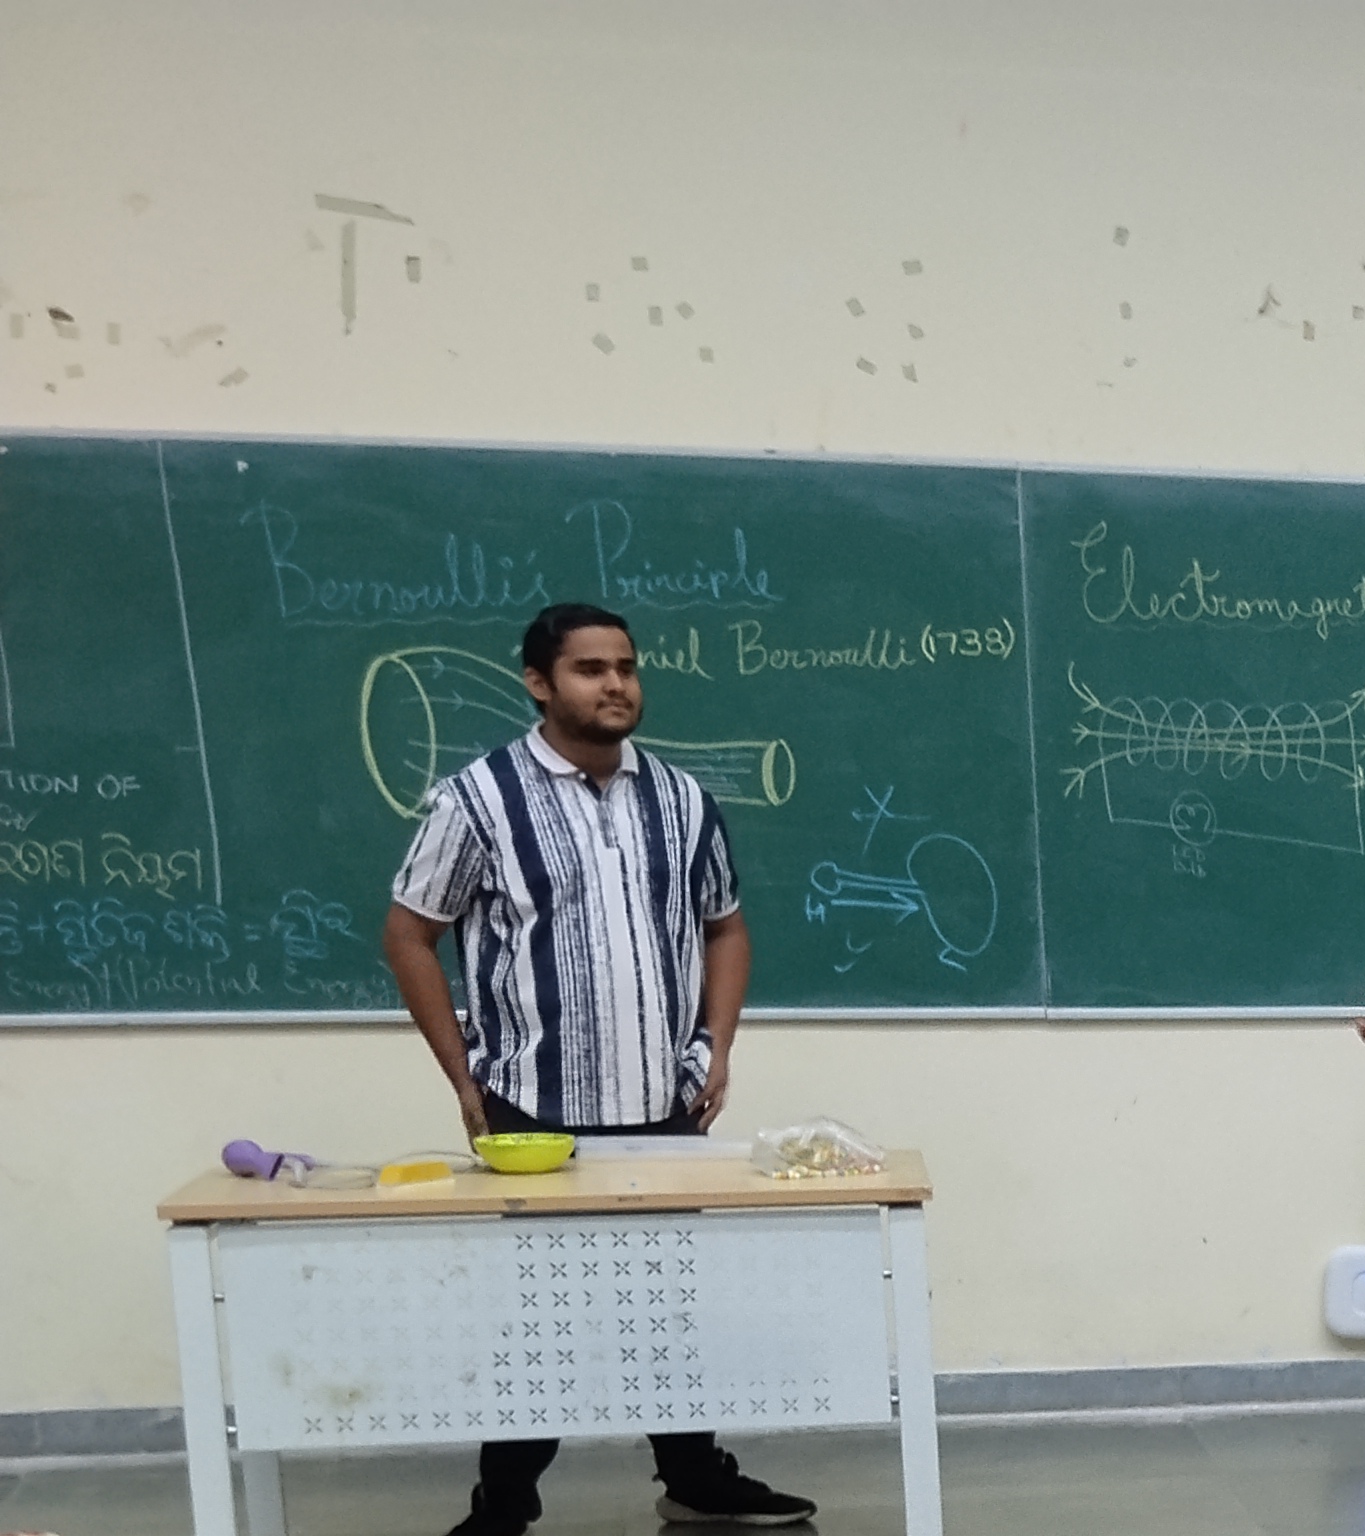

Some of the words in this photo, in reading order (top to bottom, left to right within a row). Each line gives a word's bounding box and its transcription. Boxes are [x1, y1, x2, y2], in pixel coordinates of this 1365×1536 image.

[564, 499, 784, 602] Principle
[728, 618, 917, 677] Bernoulli
[920, 616, 1015, 664] (1738)
[97, 774, 141, 800] OF
